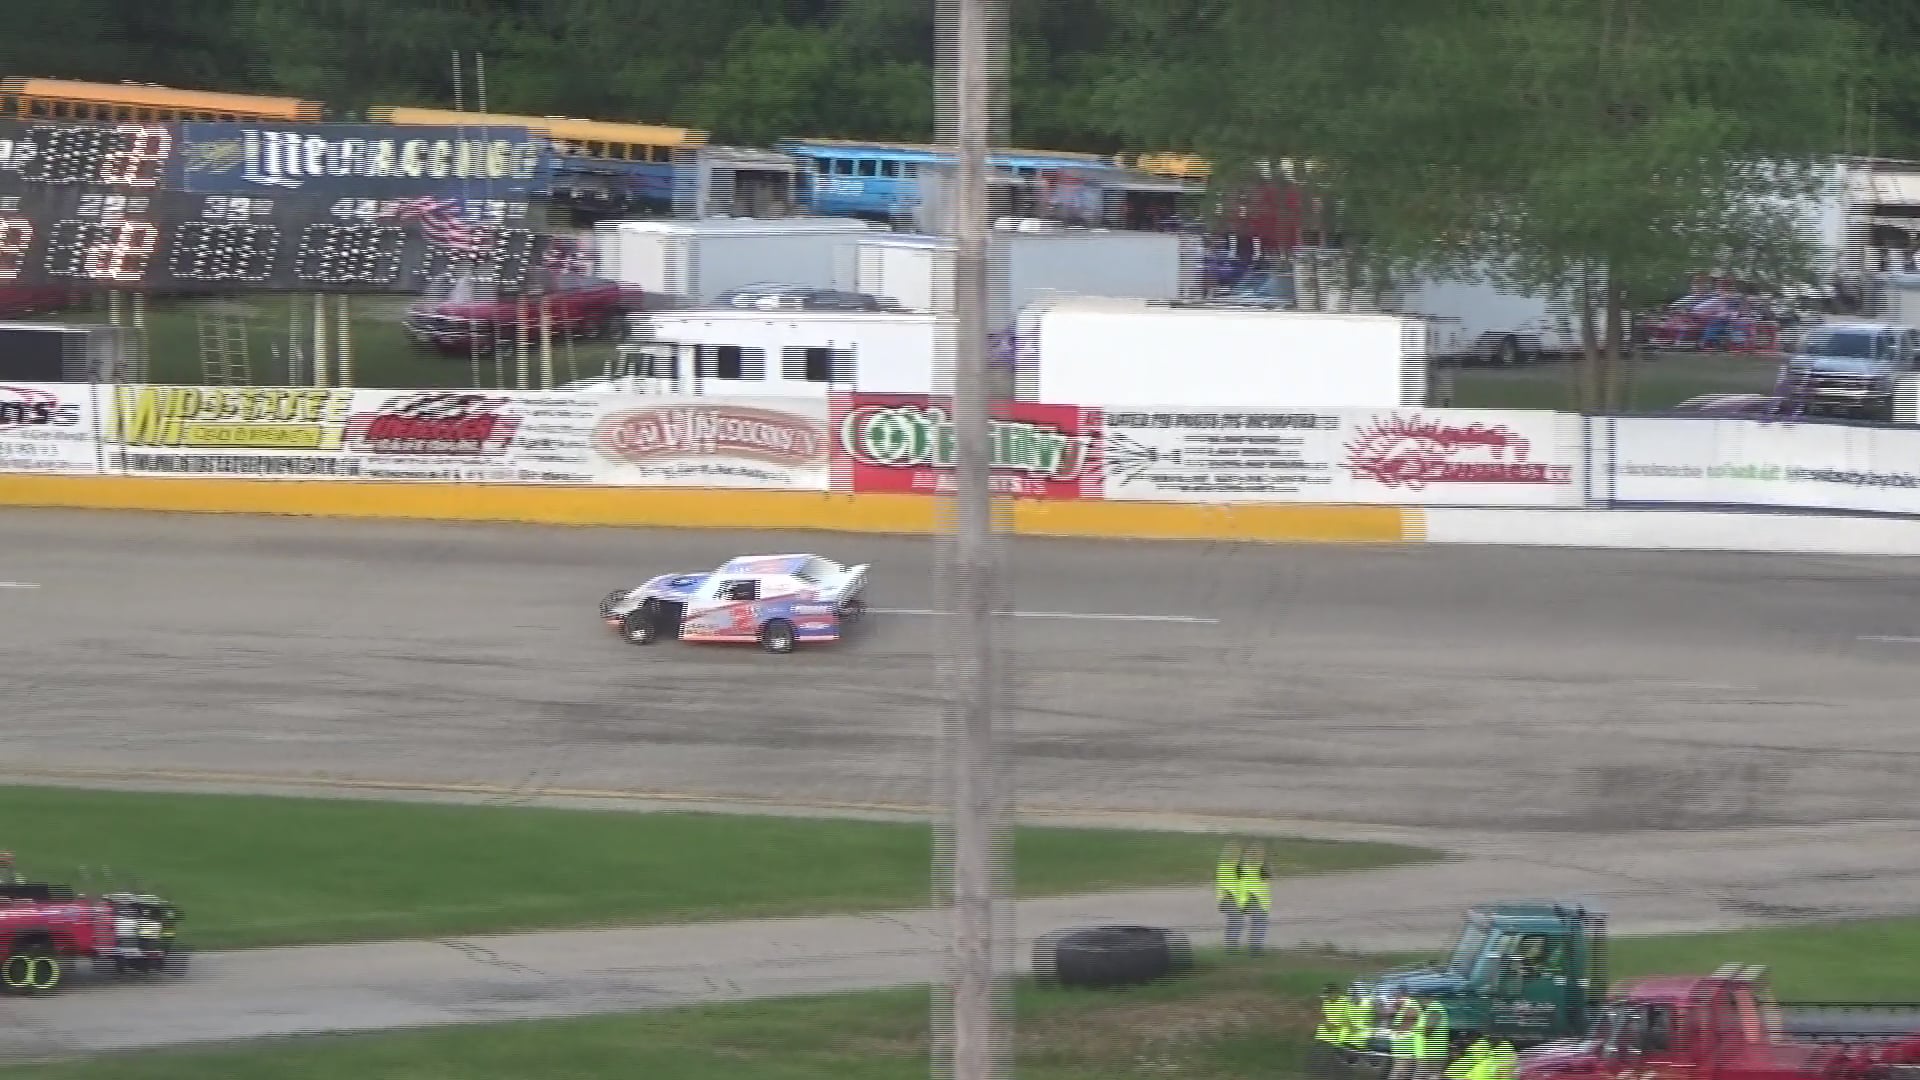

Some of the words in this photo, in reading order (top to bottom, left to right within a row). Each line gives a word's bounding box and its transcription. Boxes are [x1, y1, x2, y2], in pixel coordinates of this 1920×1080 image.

[240, 129, 352, 189] Lite
[340, 138, 537, 179] RACING
[107, 386, 354, 447] MID-STATE
[180, 425, 331, 444] EQUIPMENT
[657, 408, 821, 455] WISCONSIN
